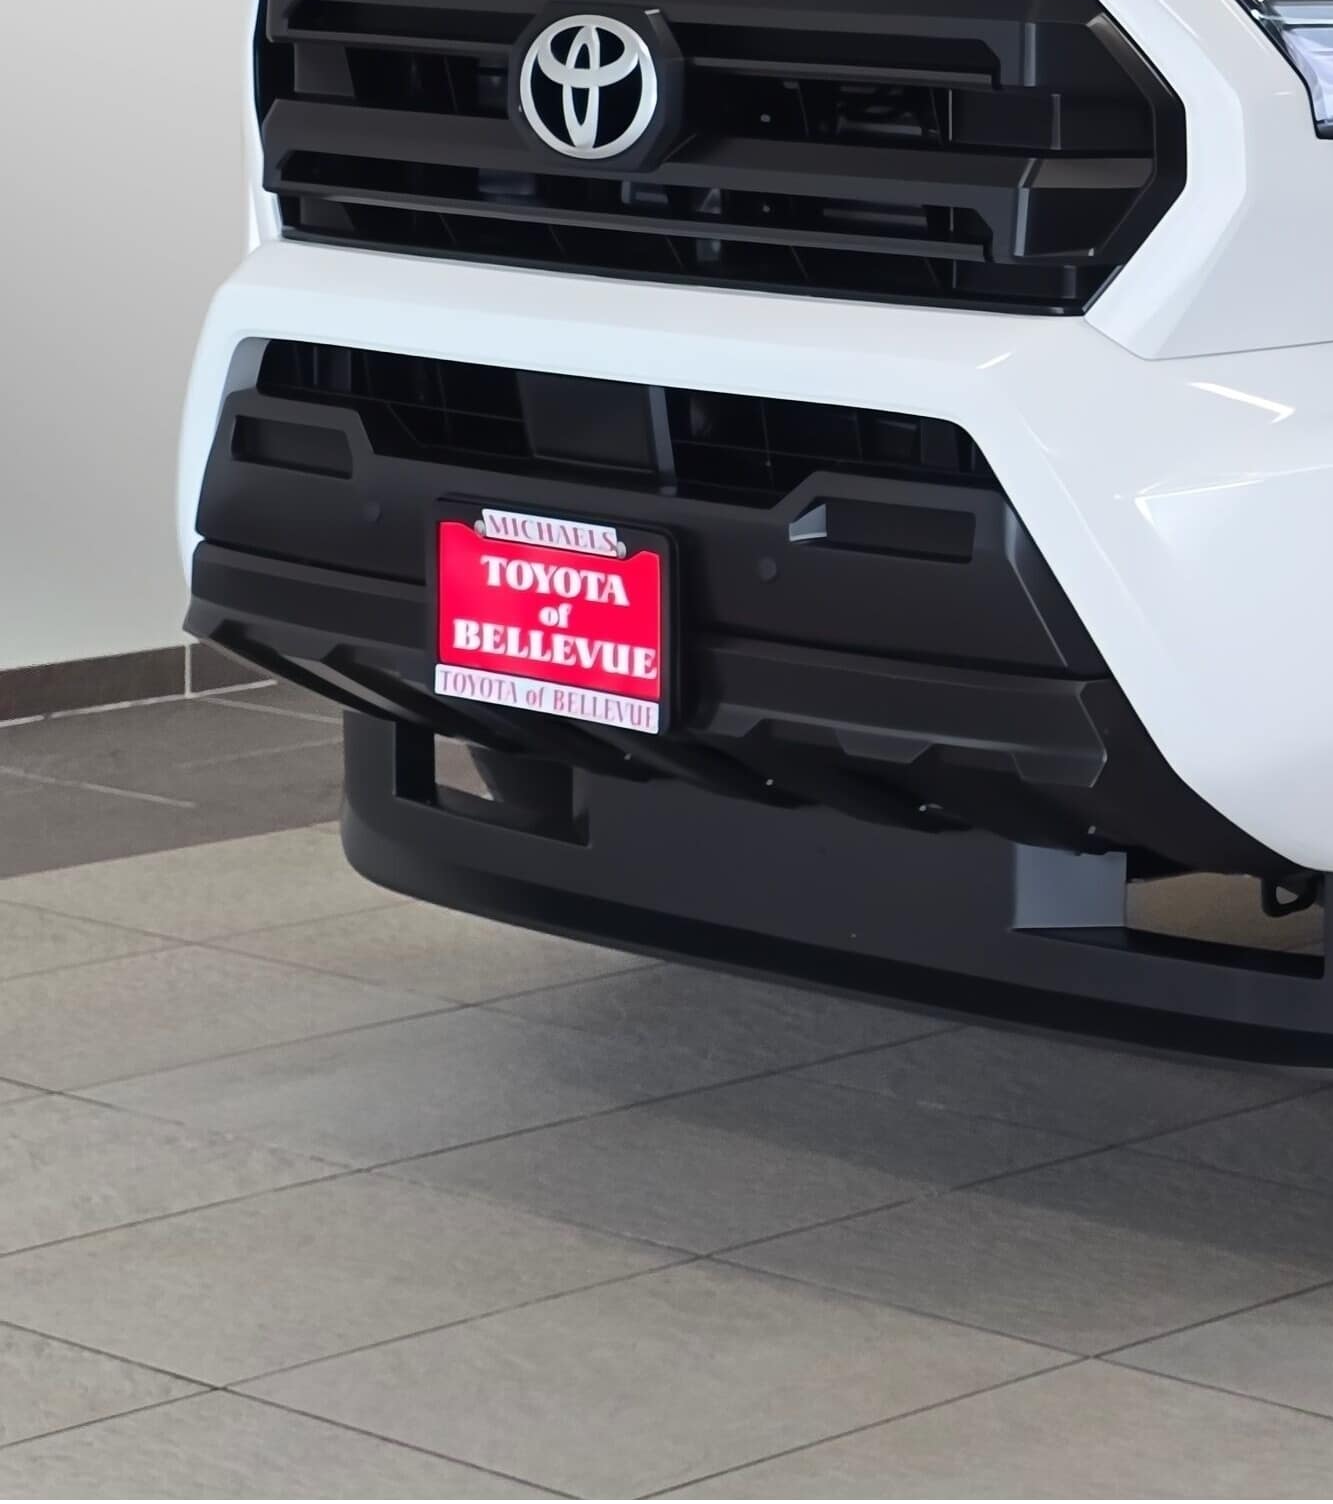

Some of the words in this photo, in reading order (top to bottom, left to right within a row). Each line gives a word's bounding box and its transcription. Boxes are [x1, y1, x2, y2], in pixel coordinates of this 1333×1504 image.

[480, 556, 630, 606] TOYOTA
[538, 604, 572, 628] of
[453, 618, 657, 679] BELLEVUE
[440, 670, 518, 704] TOYOTA
[526, 686, 545, 706] of
[553, 689, 655, 729] BELLEVUE
